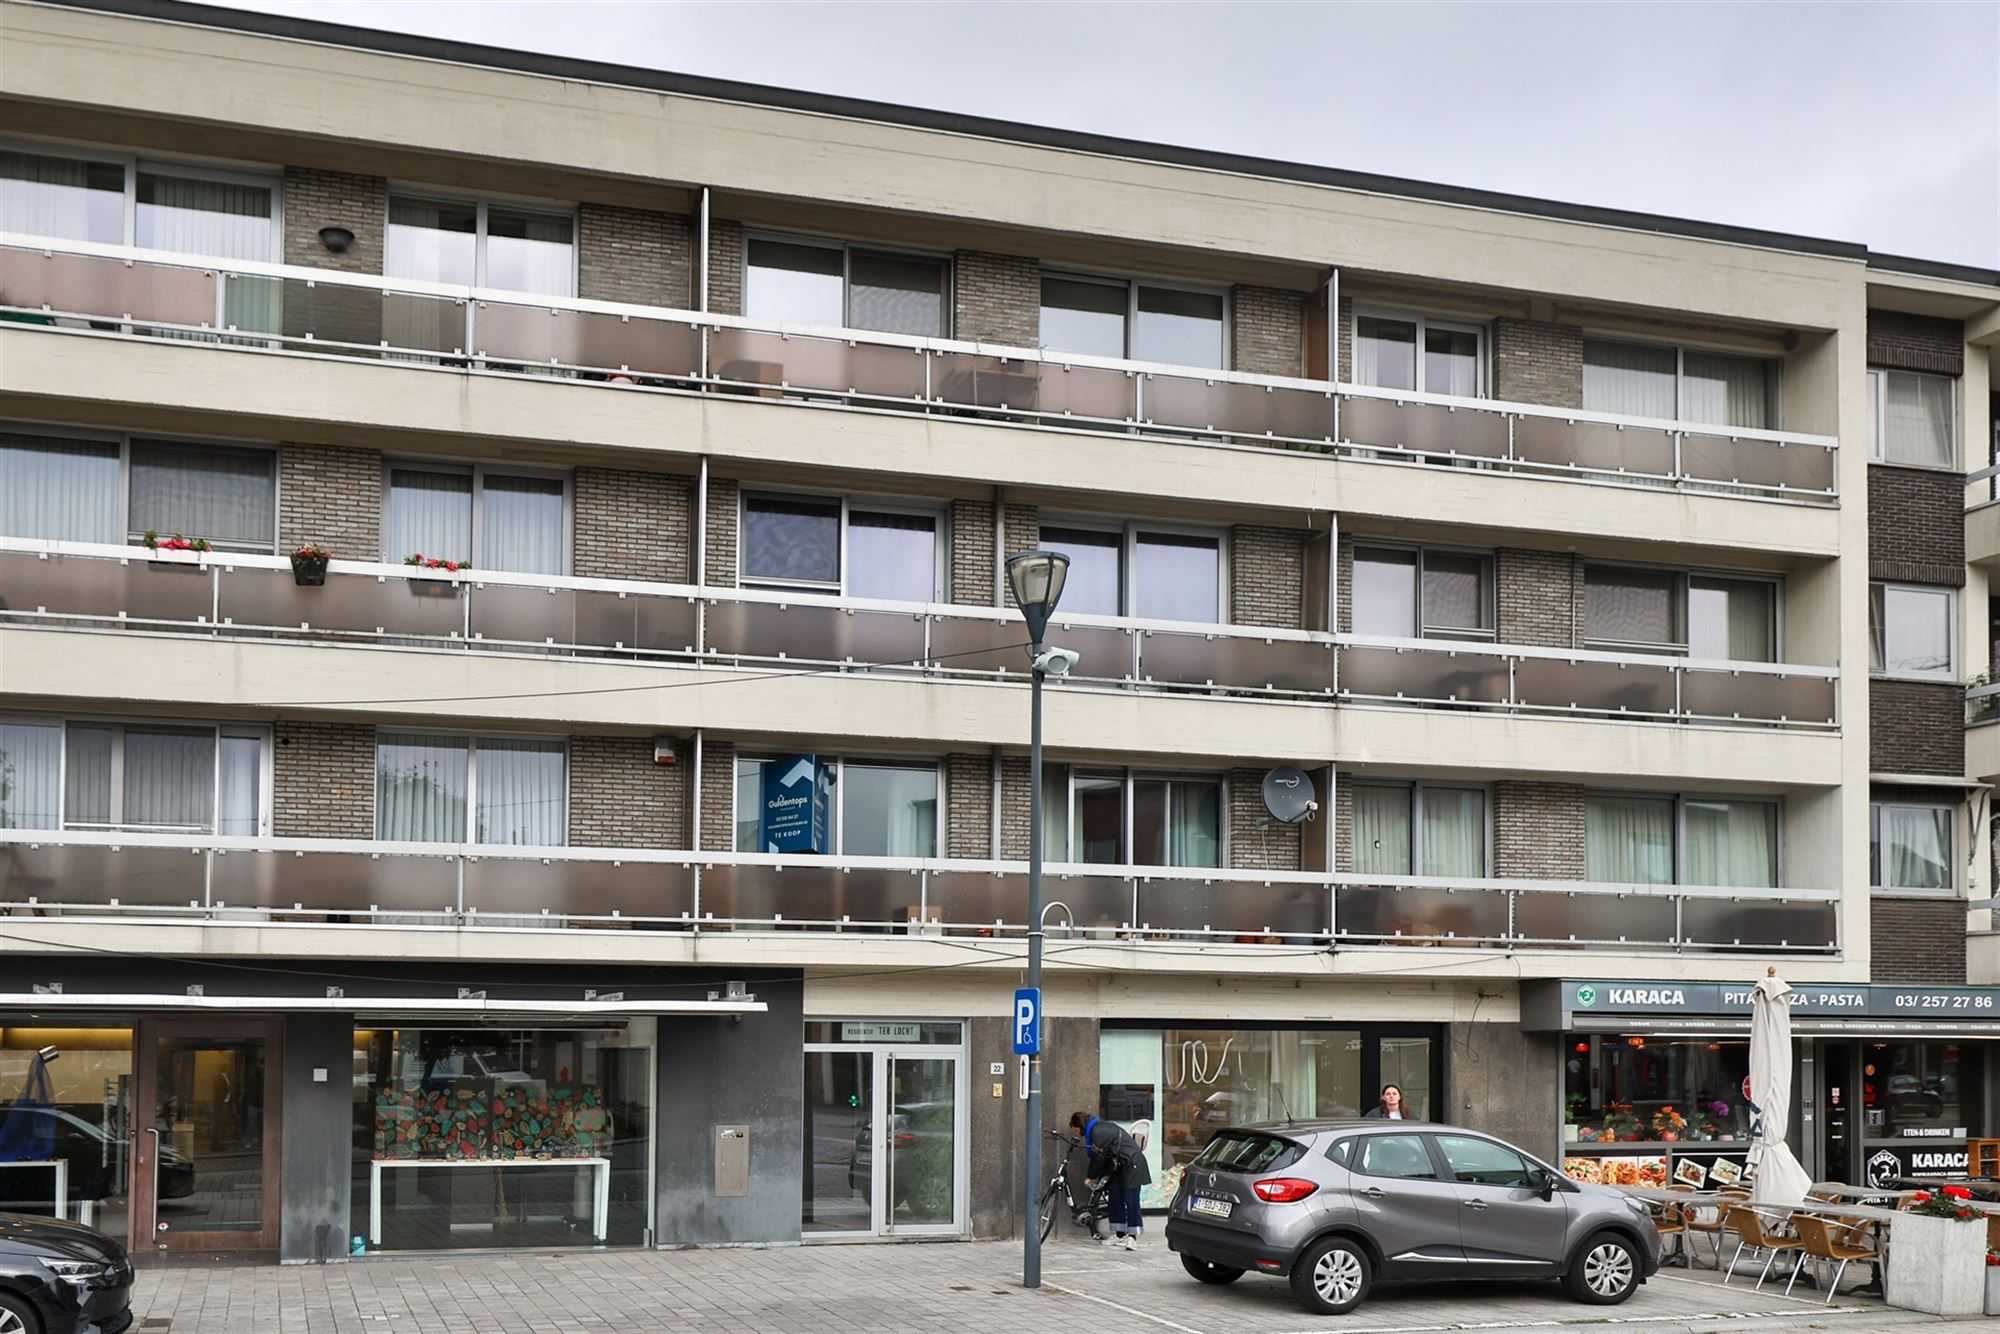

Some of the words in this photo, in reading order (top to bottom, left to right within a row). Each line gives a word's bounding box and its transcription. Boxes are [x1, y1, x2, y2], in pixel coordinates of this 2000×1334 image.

[768, 794, 808, 808] Guldentops
[783, 830, 801, 838] KOOP
[1609, 989, 1685, 1005] KARACA
[1724, 992, 1756, 1004] PITA
[1819, 994, 1864, 1006] PASTA
[1895, 995, 1918, 1007] 03/
[1922, 995, 1948, 1008] 257
[1953, 996, 1970, 1008] 27
[1974, 996, 1993, 1008] 86
[1016, 998, 1034, 1045] P
[879, 1026, 890, 1036] TER
[894, 1026, 914, 1036] LOCHT
[1903, 1128, 1918, 1137] ETEN
[1872, 1153, 1895, 1166] KARACA
